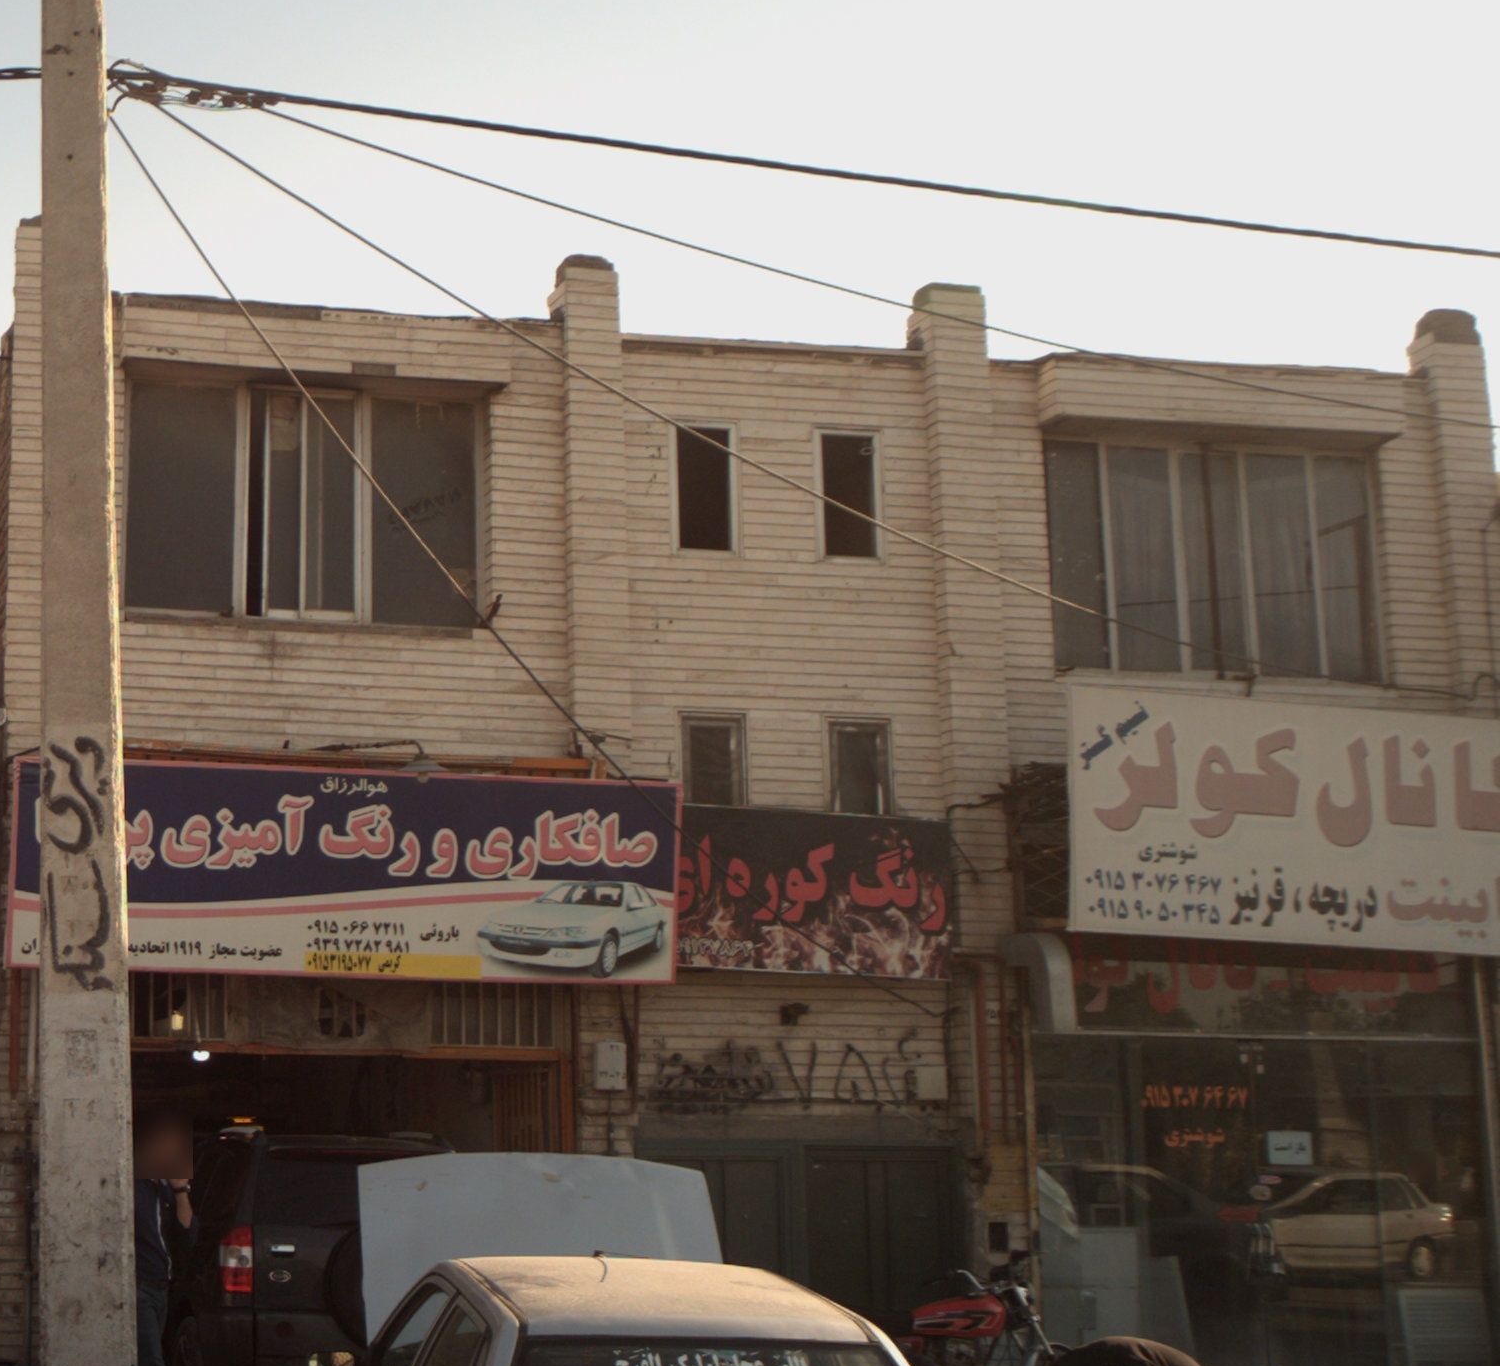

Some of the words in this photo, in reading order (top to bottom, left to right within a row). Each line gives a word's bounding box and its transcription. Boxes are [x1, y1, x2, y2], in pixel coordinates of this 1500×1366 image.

[1093, 720, 1299, 838] کولر
[160, 793, 314, 871] آمیزی
[317, 807, 418, 879] رنگ
[431, 825, 459, 879] و
[465, 807, 657, 882] صافکاری
[1137, 842, 1199, 865] شوشتری
[726, 842, 836, 922] کوره
[848, 846, 947, 933] رنگ
[1230, 866, 1285, 928] قرنیز
[1308, 882, 1378, 933] دریچه
[208, 941, 237, 960] مجاز
[240, 942, 283, 961] عضویت
